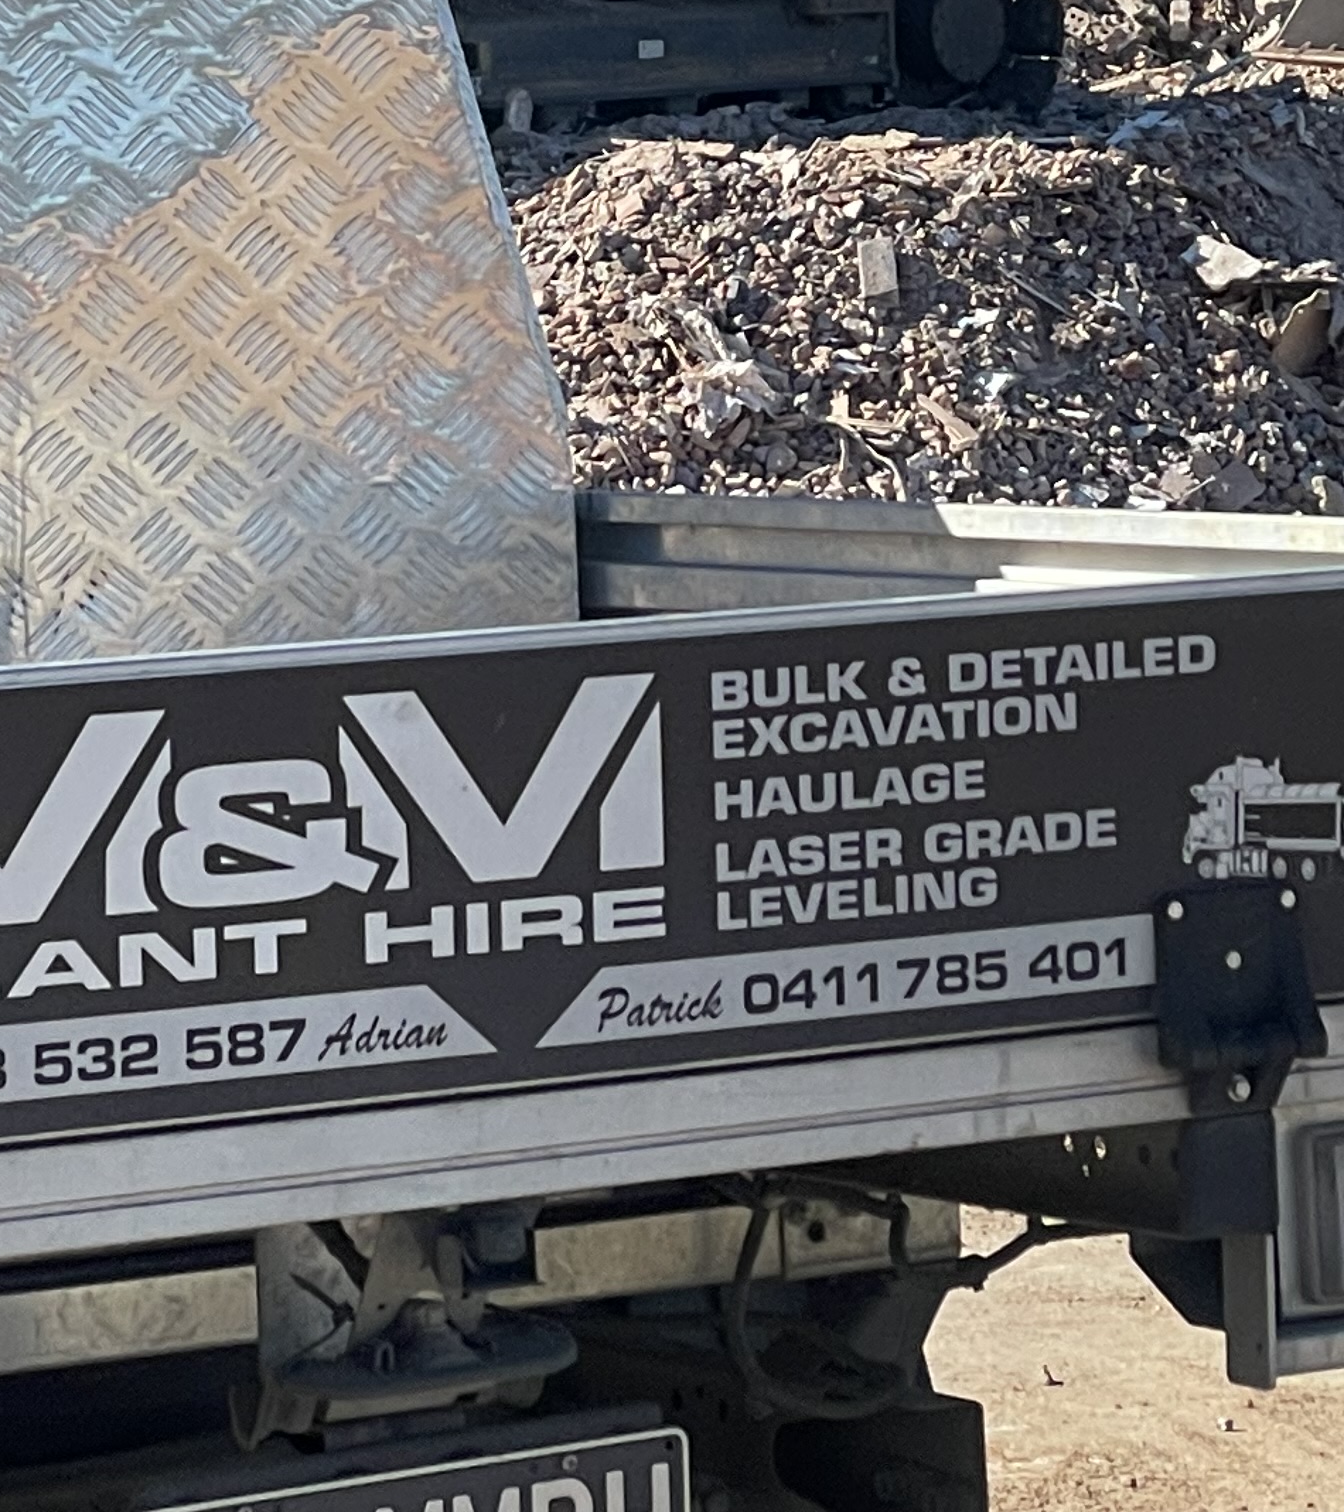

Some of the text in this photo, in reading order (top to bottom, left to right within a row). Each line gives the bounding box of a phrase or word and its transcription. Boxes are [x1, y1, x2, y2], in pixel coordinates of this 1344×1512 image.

[711, 634, 1216, 711] BULK & DETAILED
[712, 692, 1078, 760] EXCAVATION
[714, 759, 986, 821] HAULAGE
[716, 808, 1117, 883] LASER GRADE
[364, 885, 667, 965] HIRE
[716, 866, 998, 932] LEVELING
[597, 937, 1127, 1034] Patrick 0411 785 401
[33, 1033, 159, 1086] 532
[185, 1018, 307, 1071] 587
[318, 1012, 449, 1062] Adrian
